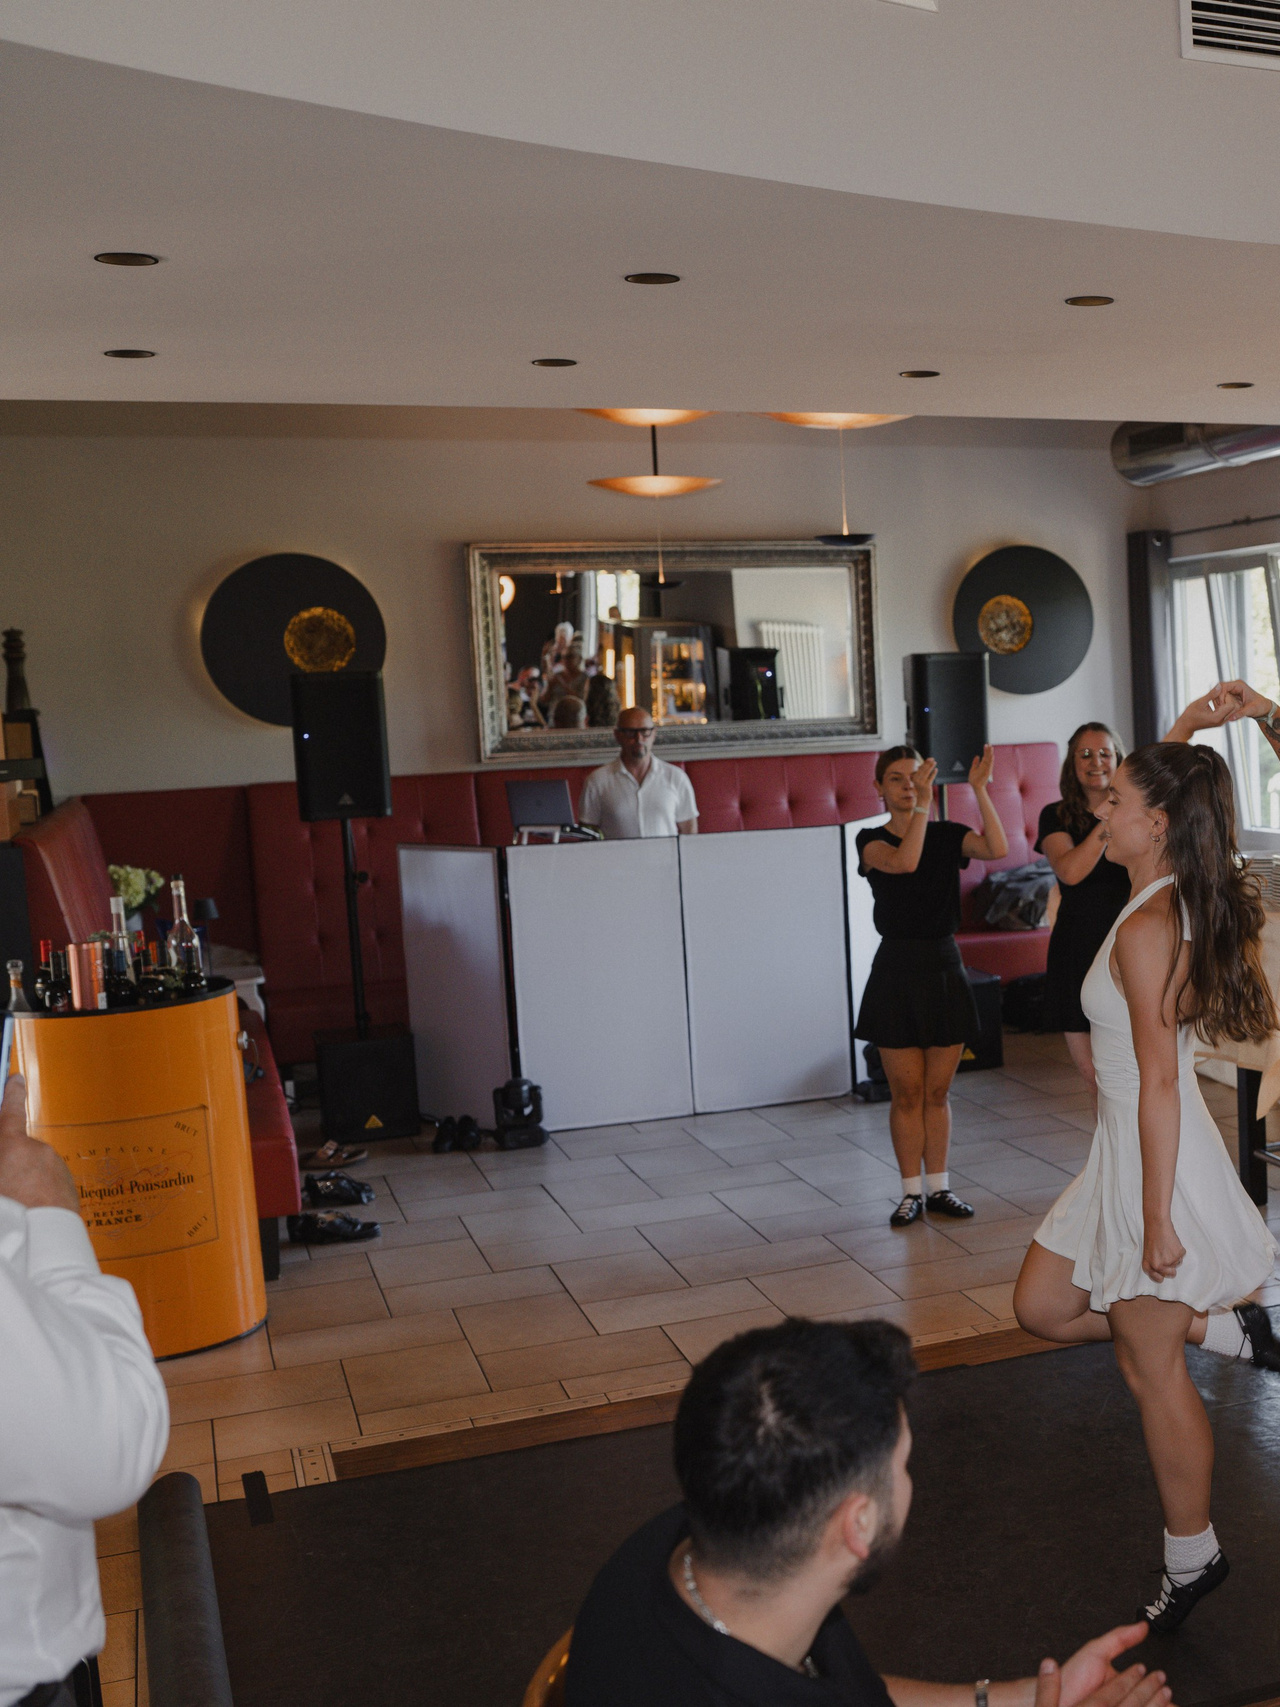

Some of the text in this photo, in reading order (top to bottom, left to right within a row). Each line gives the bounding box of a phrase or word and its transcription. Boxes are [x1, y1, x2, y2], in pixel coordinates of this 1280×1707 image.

[174, 1121, 198, 1137] BRUT
[63, 1145, 168, 1162] HAMPAGNE
[80, 1172, 195, 1200] licquot Ponsardin
[87, 1214, 143, 1227] FRANCE
[93, 1208, 134, 1218] REIMS
[186, 1215, 209, 1237] BRUT
